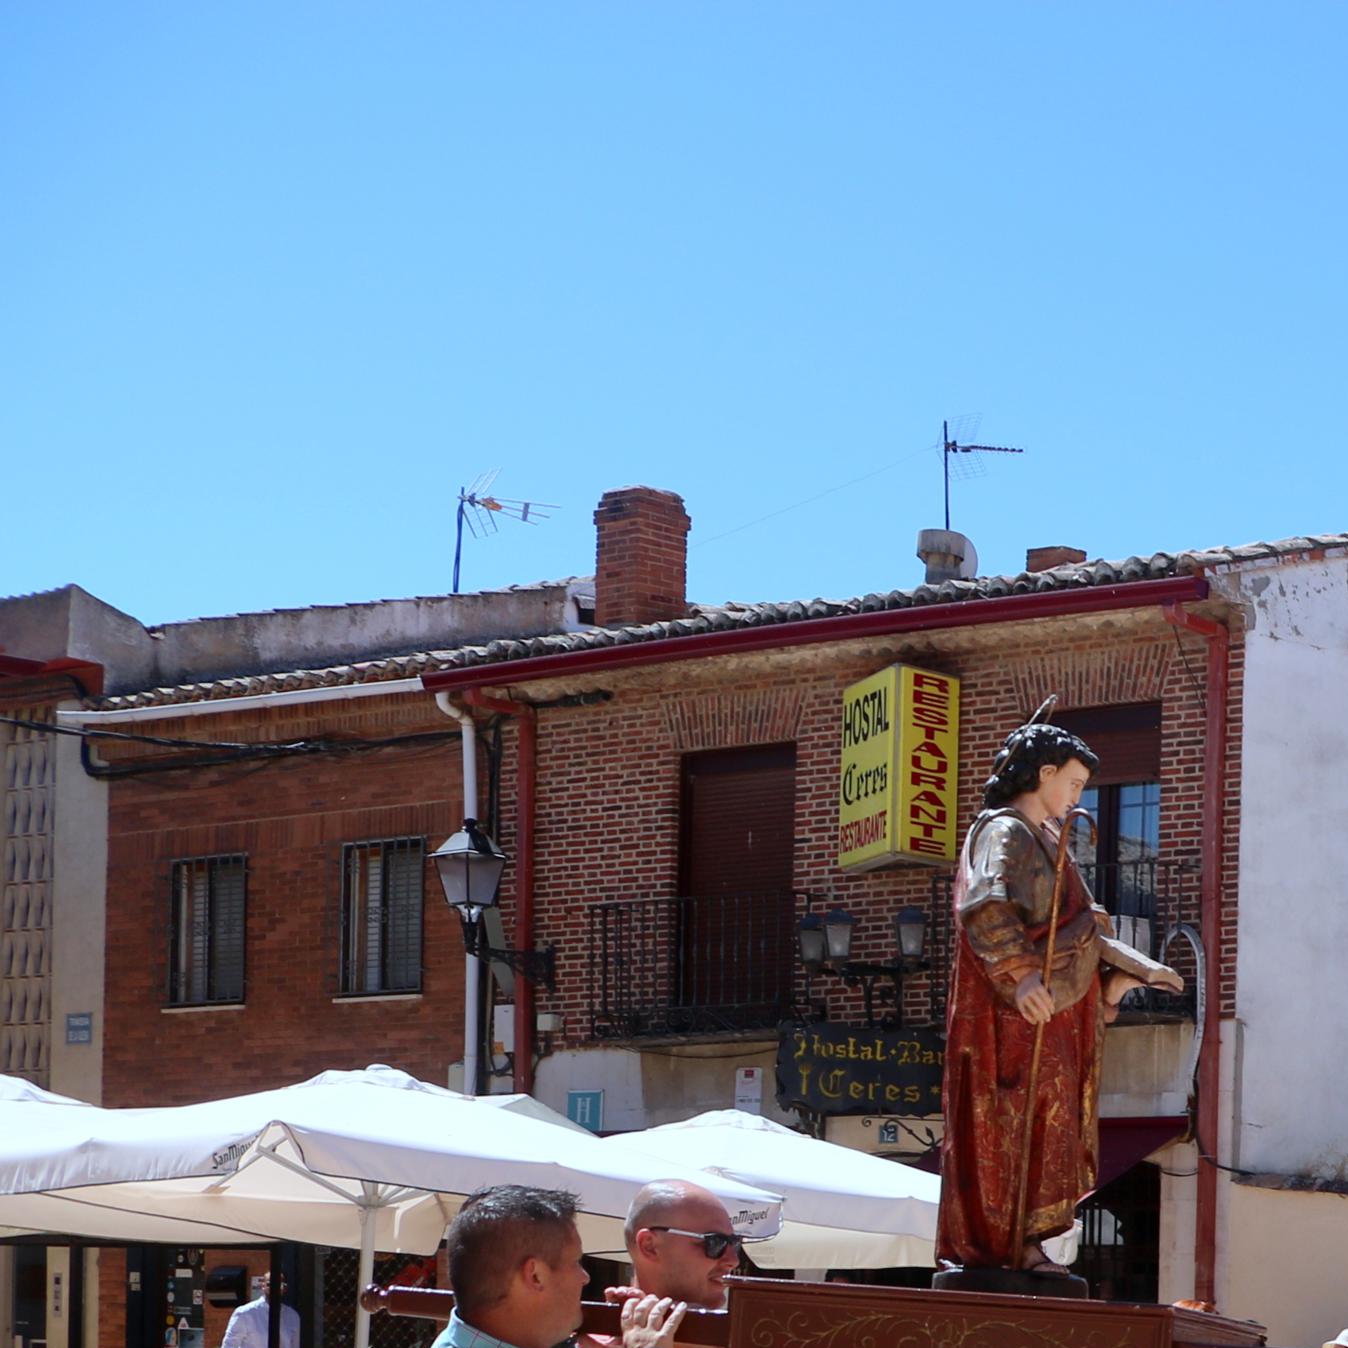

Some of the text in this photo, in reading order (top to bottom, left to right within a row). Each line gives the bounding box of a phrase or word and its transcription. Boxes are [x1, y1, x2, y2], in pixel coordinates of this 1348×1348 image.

[843, 687, 889, 748] HOSTAL
[843, 762, 888, 806] Ceres
[910, 673, 950, 856] RESTAURANTE
[840, 810, 887, 853] RESTAURANTE
[793, 1033, 887, 1062] Hostal
[818, 1068, 921, 1102] Ceres
[882, 1127, 896, 1142] 12
